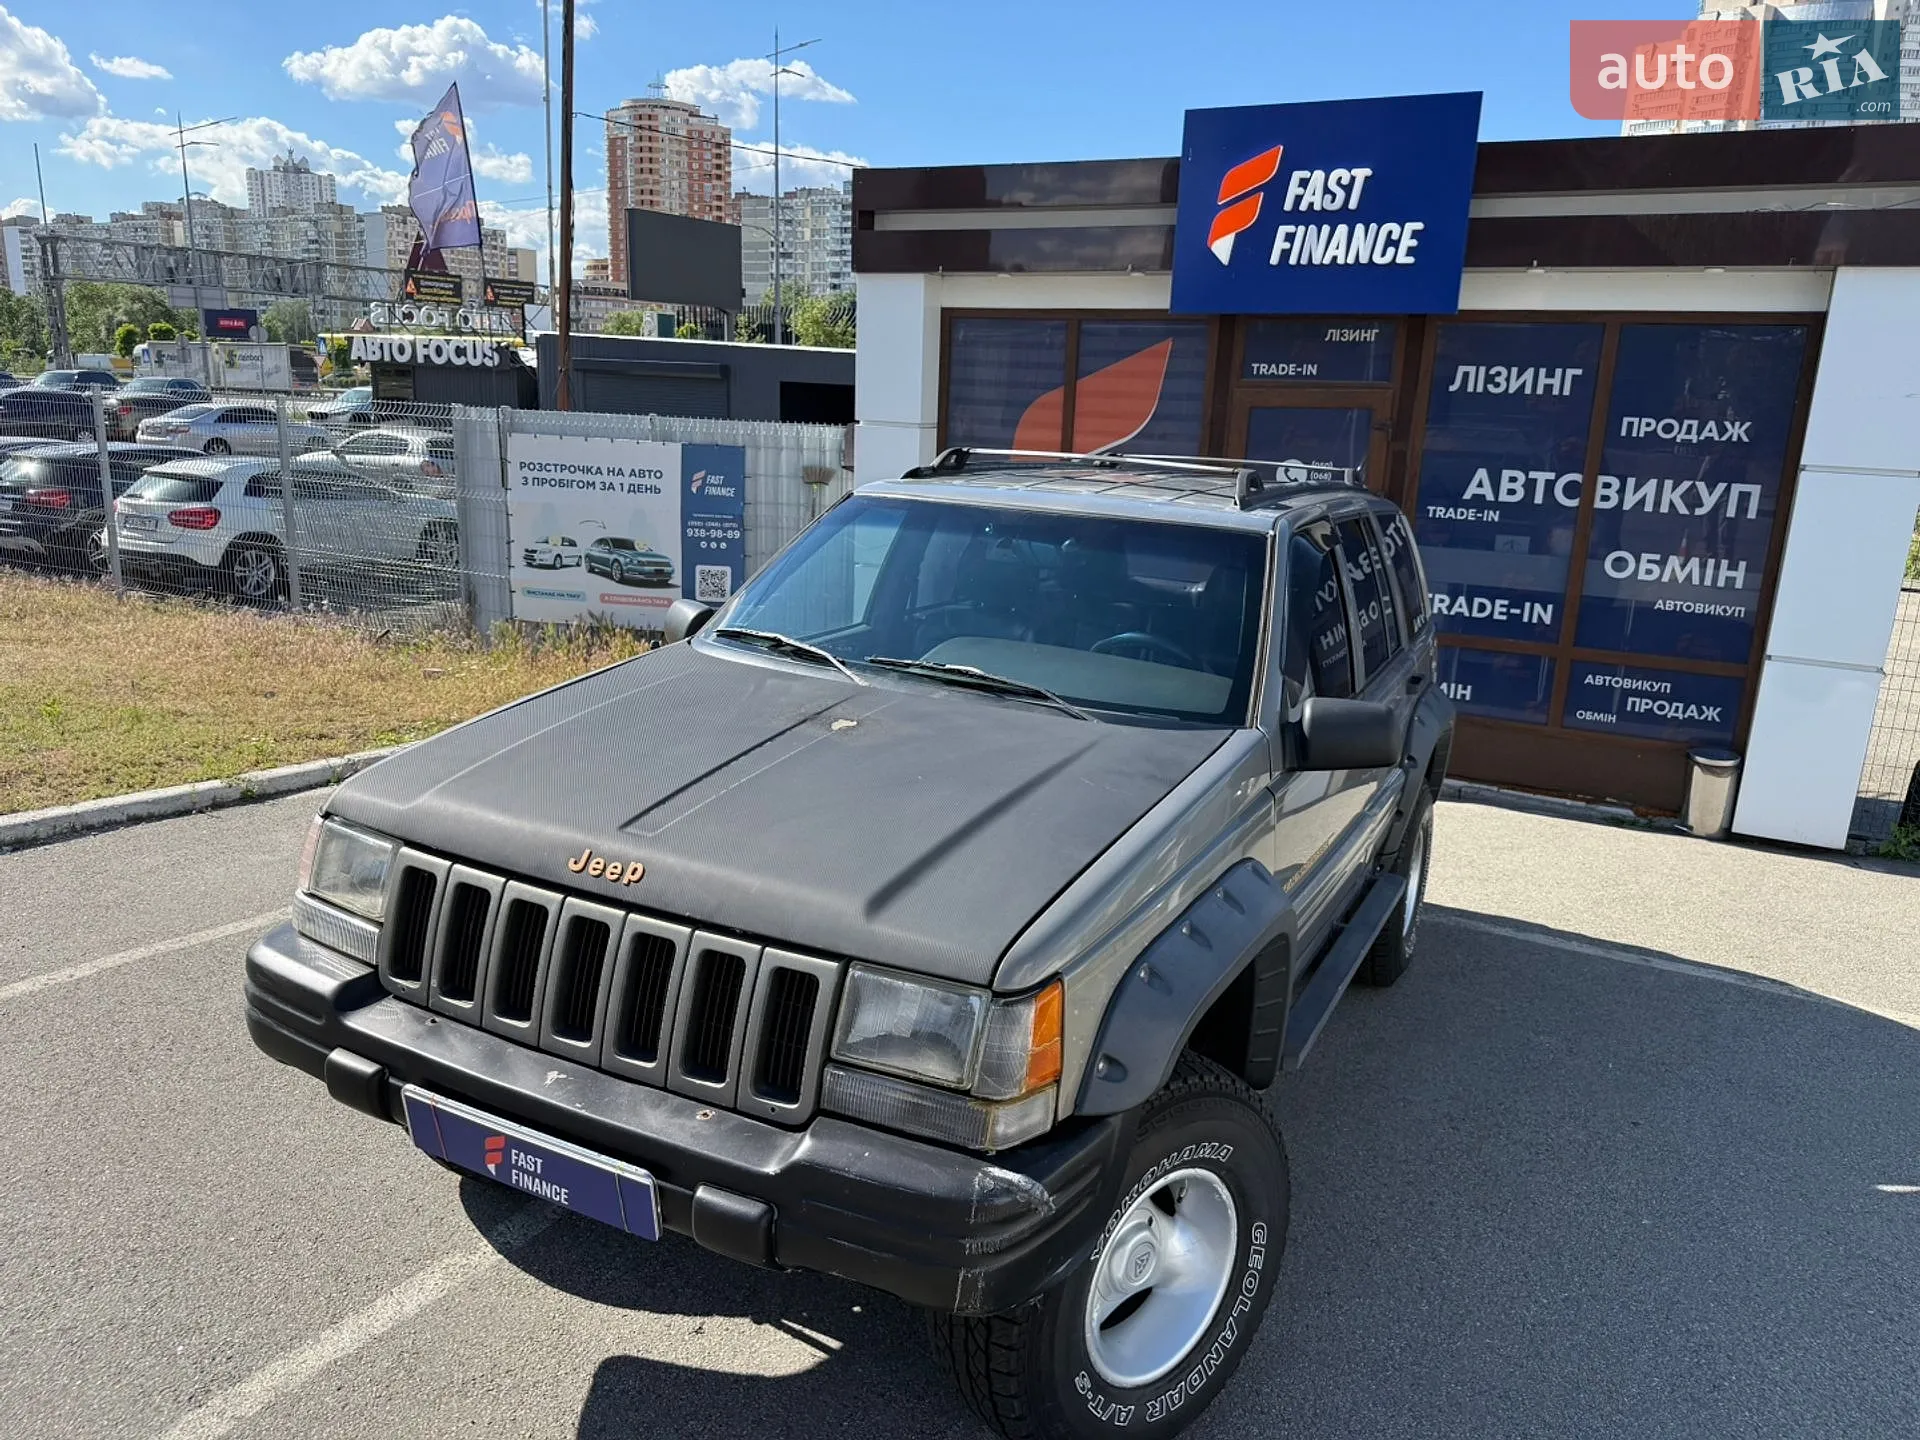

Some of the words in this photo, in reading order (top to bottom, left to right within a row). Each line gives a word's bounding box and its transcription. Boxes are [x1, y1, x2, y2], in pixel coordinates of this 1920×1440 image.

[1283, 167, 1373, 212] FAST
[1269, 221, 1425, 266] FINANCE
[1325, 329, 1379, 342] ЛІЗИНГ
[350, 337, 412, 363] АВТО
[416, 338, 500, 367] FOCUS
[1252, 363, 1318, 376] TRADE-IN
[1448, 365, 1583, 396] ЛІЗИНГ
[1620, 417, 1752, 443] ПРОДАЖ
[518, 461, 603, 476] РОЗСТРОЧКА
[606, 467, 625, 478] НА
[628, 468, 663, 480] АВТО
[706, 475, 724, 485] FAST
[531, 477, 596, 491] ПРОБІГОМ
[600, 481, 616, 492] ЗА
[618, 483, 624, 493] 1
[626, 483, 662, 495] ДЕНЬ
[704, 486, 736, 497] FINANCE
[1462, 468, 1762, 519] АВТОВИКУП
[1427, 506, 1500, 523] TRADE-IN
[686, 528, 740, 539] 938-98-89
[1604, 550, 1747, 589] ОБМІН
[1428, 593, 1553, 625] RADE-IN
[1654, 599, 1746, 618] АВТОВИКУП
[1584, 674, 1672, 694] АВТОВИКУП
[1576, 710, 1617, 724] ОБМІН
[1626, 696, 1722, 722] ПРОДАЖ
[567, 849, 647, 886] Jeep
[511, 1147, 543, 1175] FAST
[511, 1168, 570, 1206] FINANCE
[1090, 1142, 1234, 1261] YOKOHAMA
[1145, 1222, 1267, 1423] GEOLANDAR
